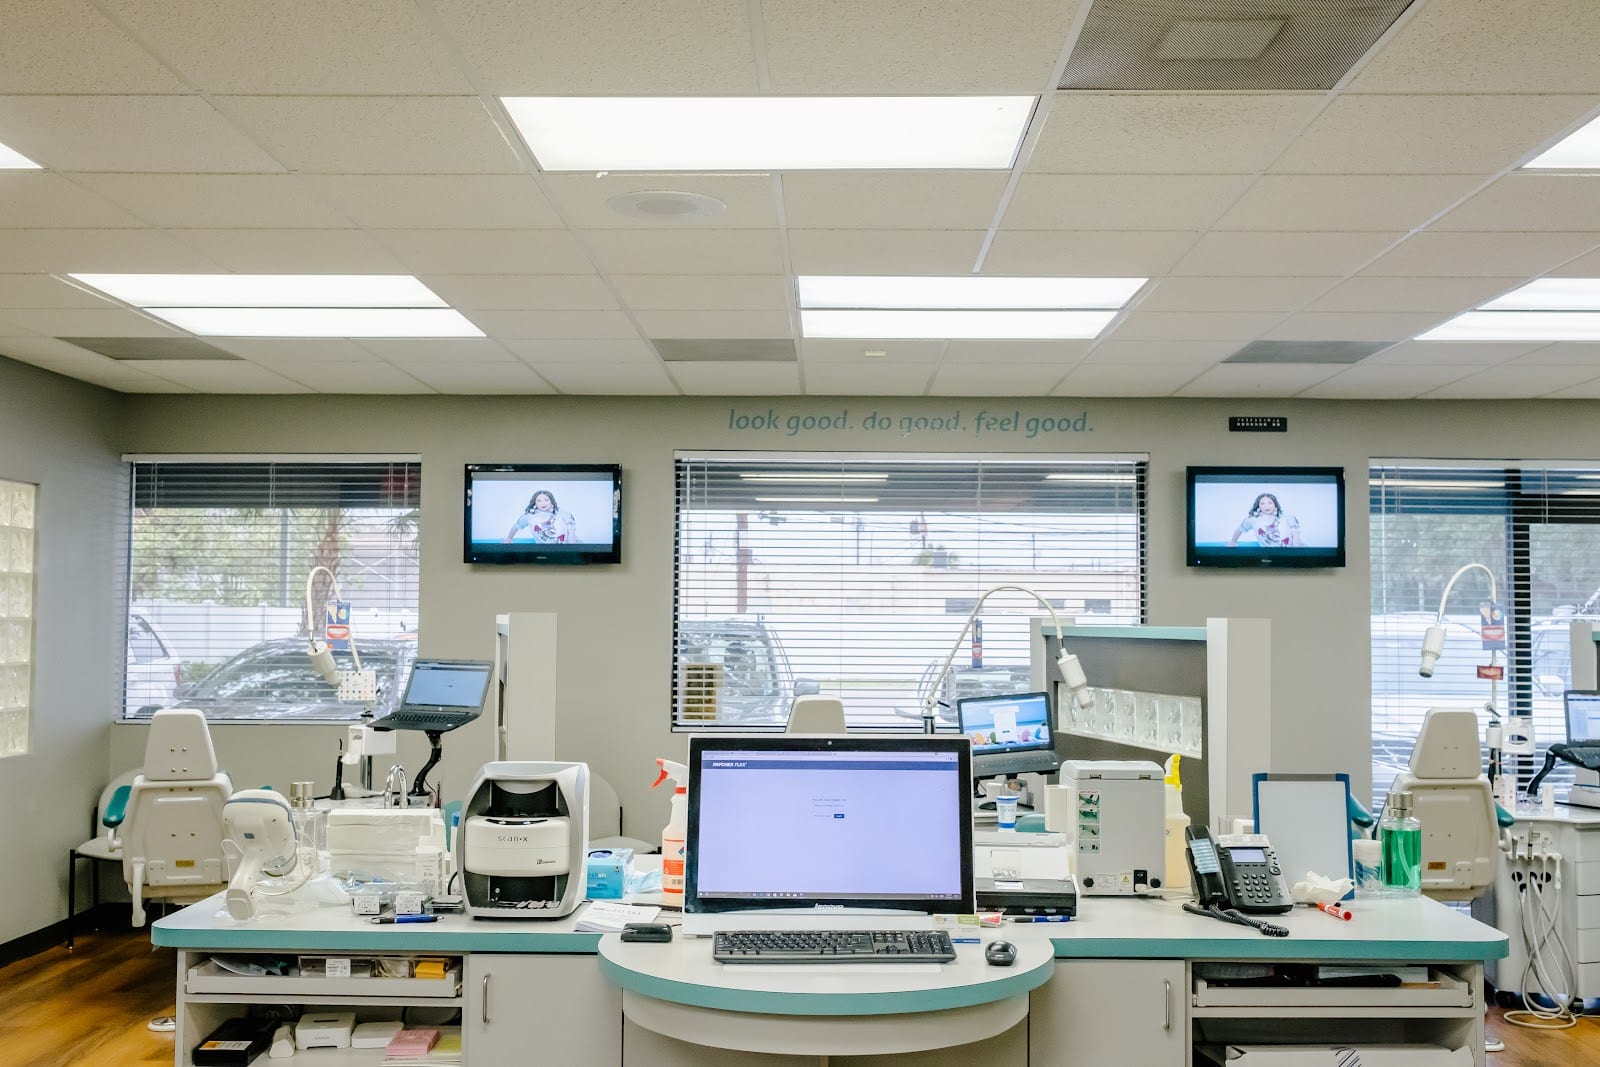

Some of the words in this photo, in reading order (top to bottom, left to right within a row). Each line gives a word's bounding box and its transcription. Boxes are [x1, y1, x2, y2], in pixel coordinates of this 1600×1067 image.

[729, 409, 780, 431] look
[786, 410, 854, 436] good.
[863, 411, 893, 431] do
[899, 411, 967, 436] good.
[974, 411, 1019, 438] feel
[1025, 412, 1094, 438] good.
